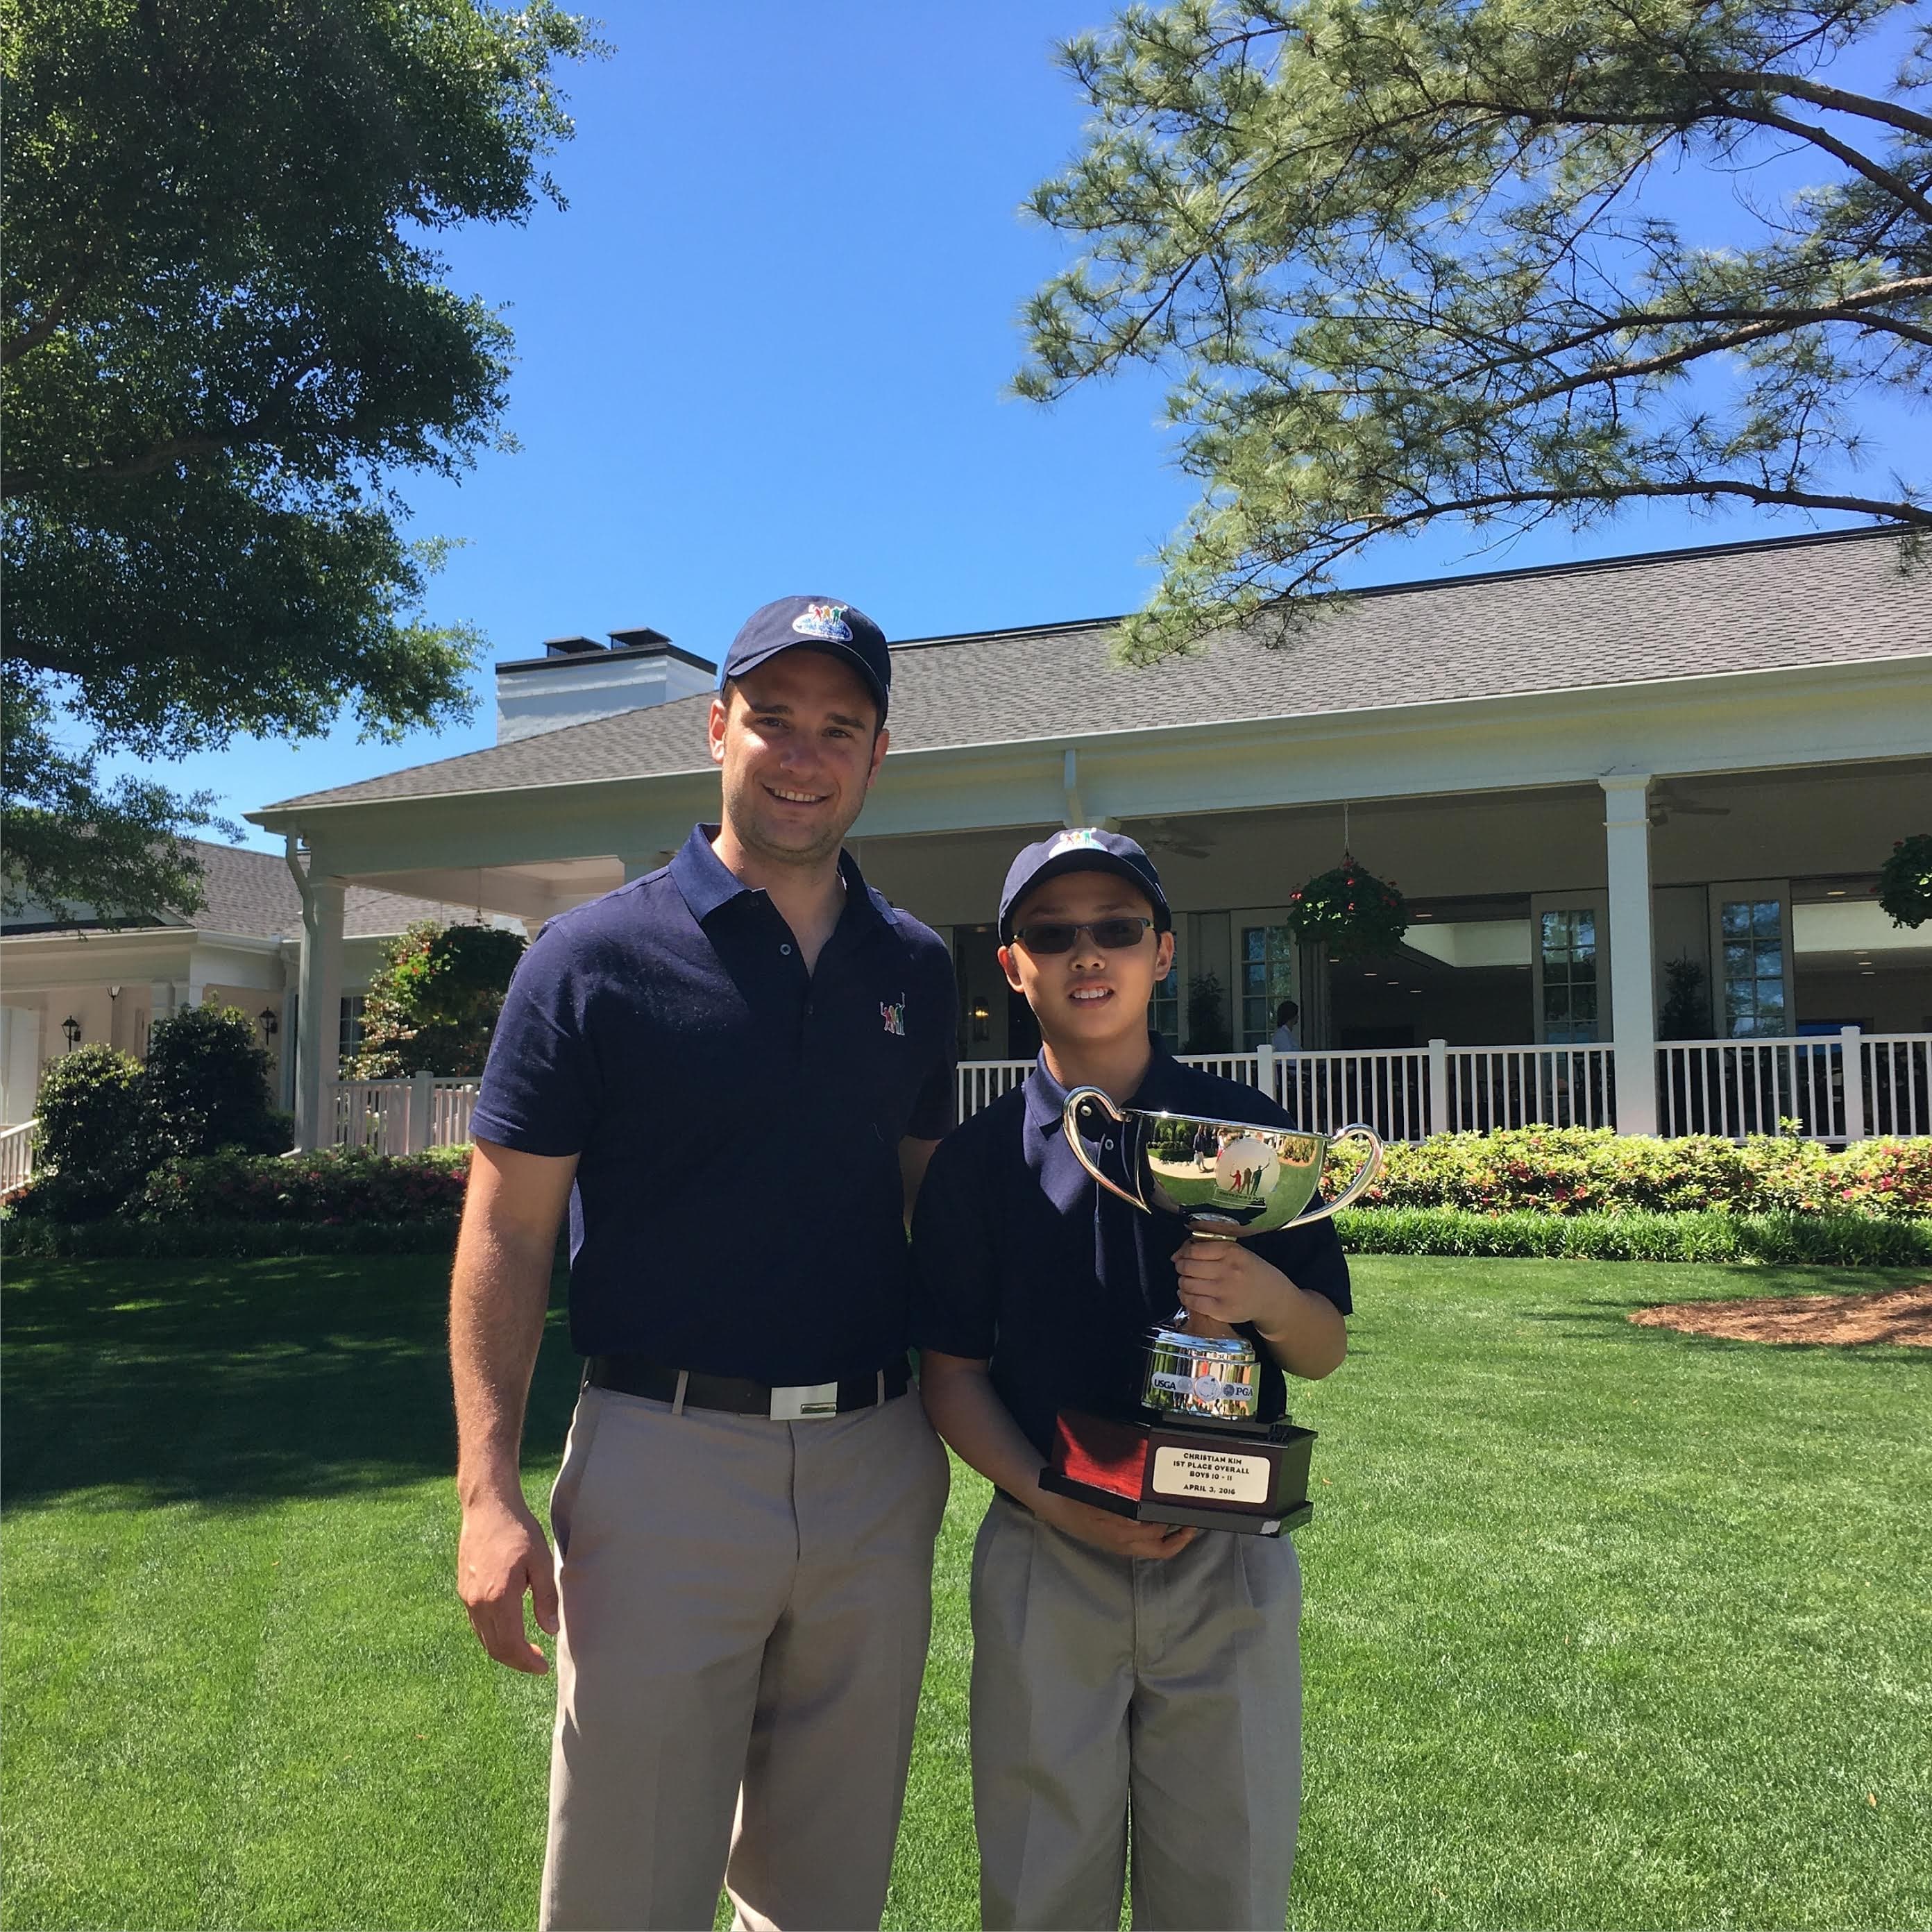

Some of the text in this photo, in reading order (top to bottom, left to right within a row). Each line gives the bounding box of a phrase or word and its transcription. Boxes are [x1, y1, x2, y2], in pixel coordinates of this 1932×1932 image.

[1154, 1379, 1176, 1390] USGA
[1235, 1387, 1253, 1396] PGA
[1183, 1452, 1226, 1463] CHRISTIAN
[1214, 1465, 1249, 1474] OVERALL
[1189, 1471, 1210, 1479] BOYS
[1183, 1484, 1206, 1492] APRIL
